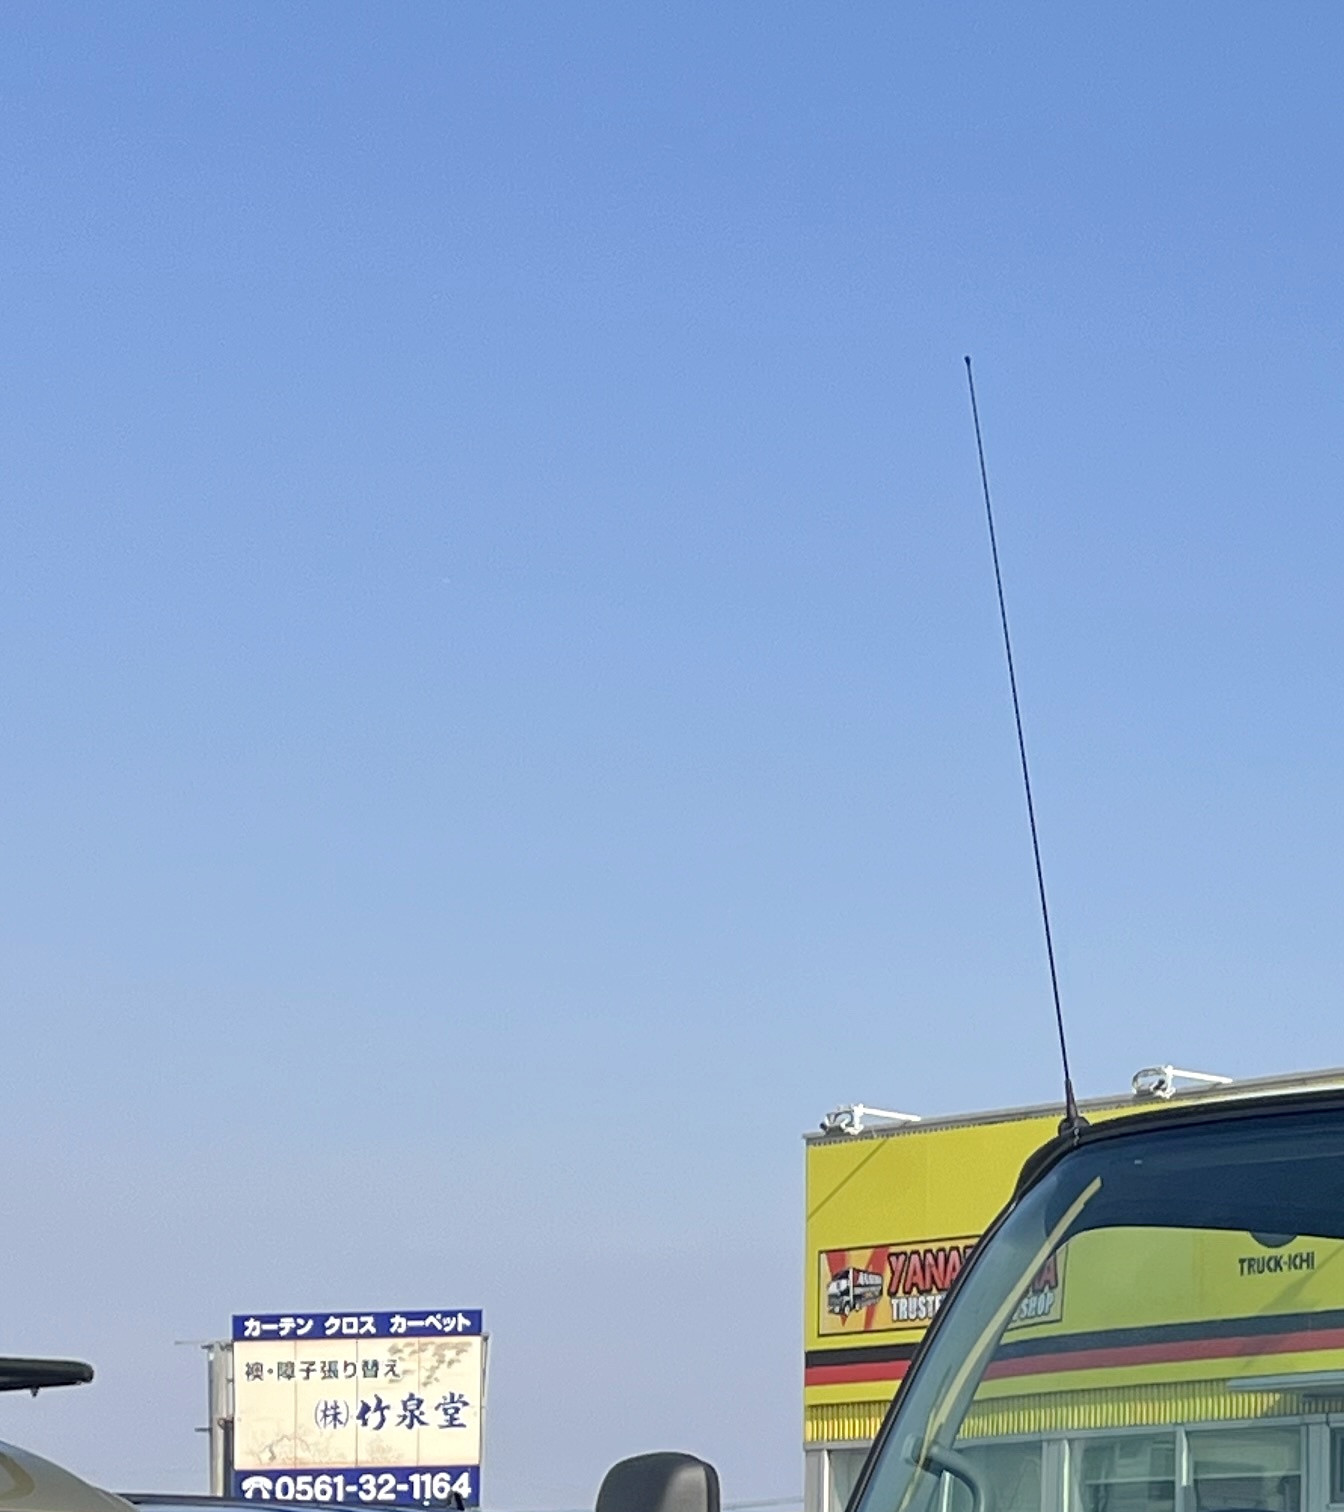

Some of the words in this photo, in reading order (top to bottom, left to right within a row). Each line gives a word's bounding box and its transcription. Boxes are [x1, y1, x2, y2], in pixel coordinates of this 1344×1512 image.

[1238, 1251, 1315, 1276] TRUCK-ICHI
[243, 1317, 314, 1337] カーテン
[324, 1315, 377, 1336] クロス
[389, 1312, 472, 1334] カーペット
[274, 1471, 472, 1502] 0561-32-1164
